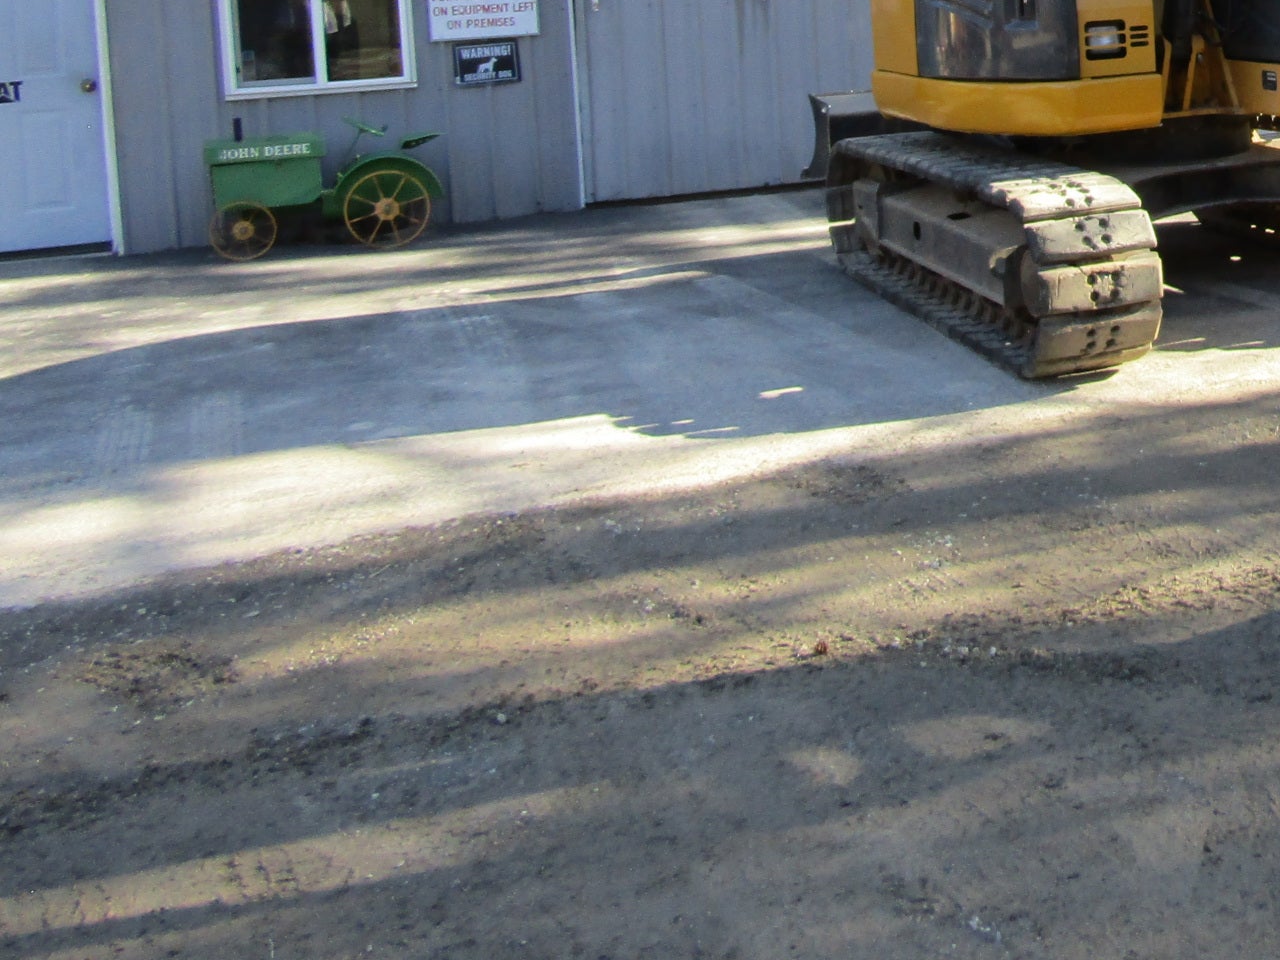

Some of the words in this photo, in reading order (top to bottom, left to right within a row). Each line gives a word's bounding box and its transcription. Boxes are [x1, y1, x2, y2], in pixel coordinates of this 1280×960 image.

[433, 7, 448, 17] ON
[452, 4, 509, 16] EQUIPMENT
[514, 2, 535, 13] LEFT
[447, 21, 462, 30] ON
[467, 17, 516, 29] PREMISES
[461, 45, 511, 60] WARNING!
[0, 80, 23, 104] AT
[219, 146, 259, 160] JOHN
[263, 142, 311, 157] DEERE
